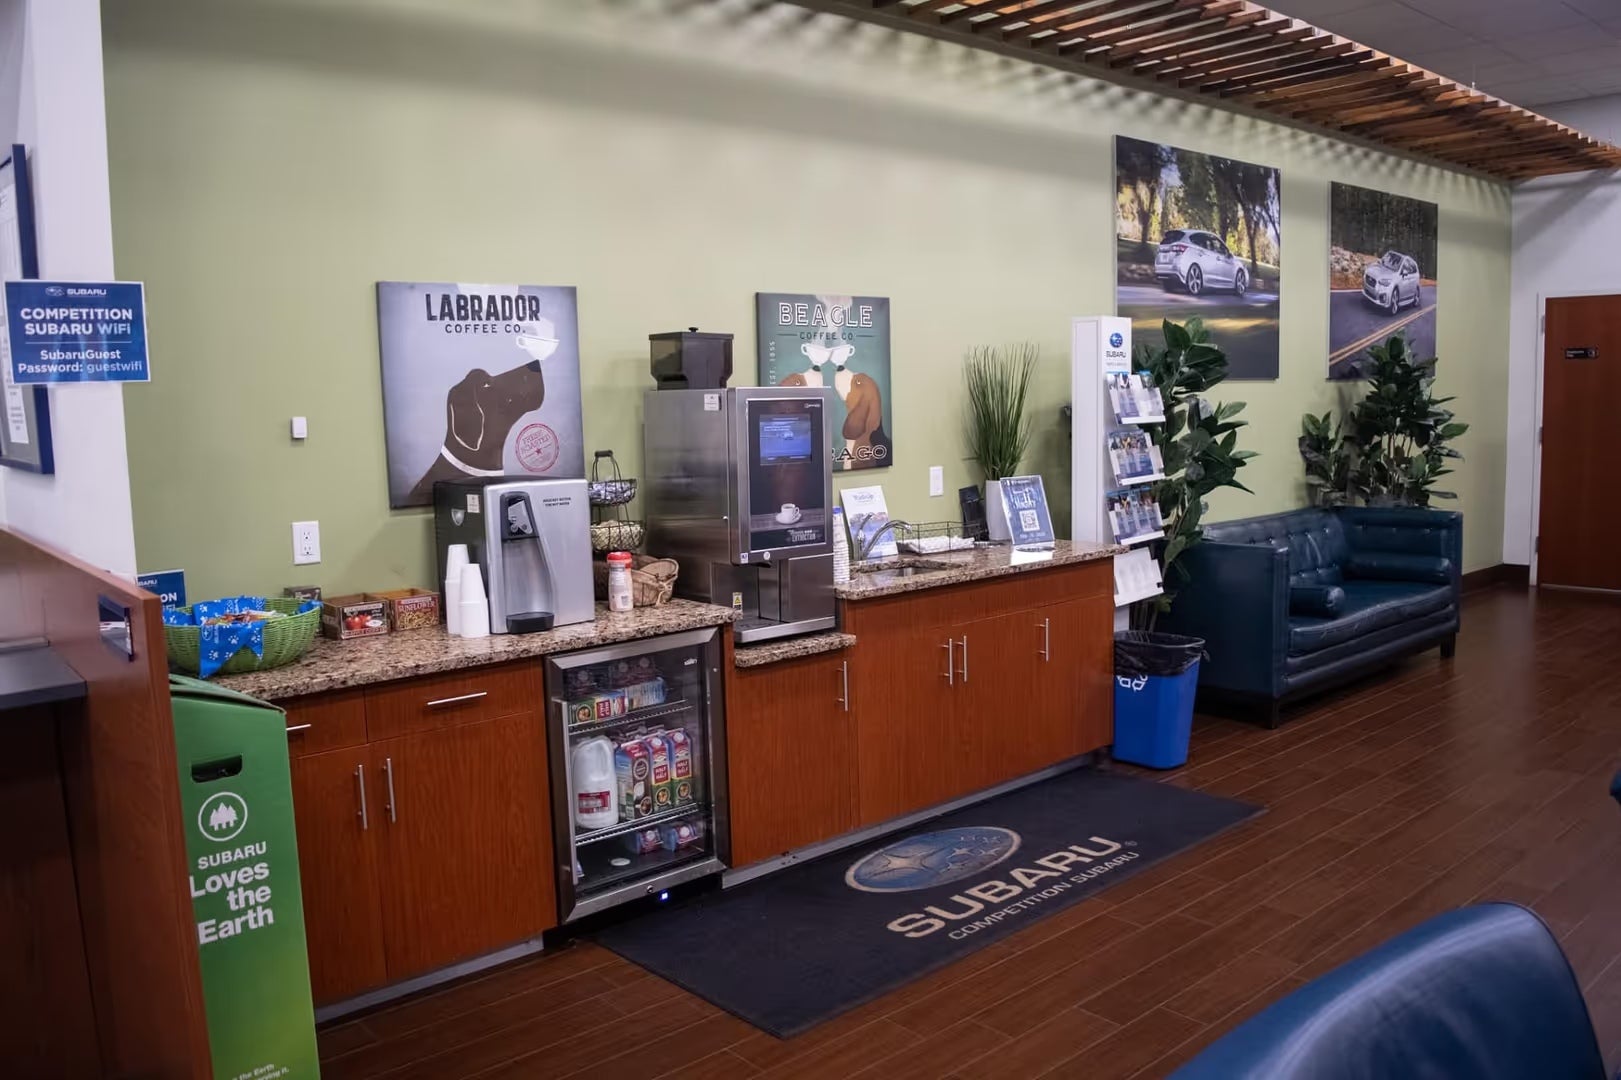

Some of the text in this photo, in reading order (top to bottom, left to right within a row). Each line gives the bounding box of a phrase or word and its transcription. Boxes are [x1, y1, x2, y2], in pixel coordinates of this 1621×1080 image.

[67, 288, 107, 296] SUBARU
[20, 308, 133, 320] COMPETITION
[425, 293, 541, 322] LABRADOR
[778, 302, 873, 328] BEAGLE
[24, 322, 131, 335] SUBARU WiFi
[445, 324, 526, 333] COFFEE CO.
[800, 332, 837, 341] COFFEE
[18, 361, 143, 374] Password: guestwifi
[40, 350, 121, 360] SubaruGuest
[197, 841, 267, 870] SUBARU
[189, 862, 270, 898] Loves
[886, 835, 1122, 939] SUBARU
[227, 885, 272, 911] the
[948, 851, 1139, 941] COMPETITION SUBARU
[197, 906, 274, 945] Earth
